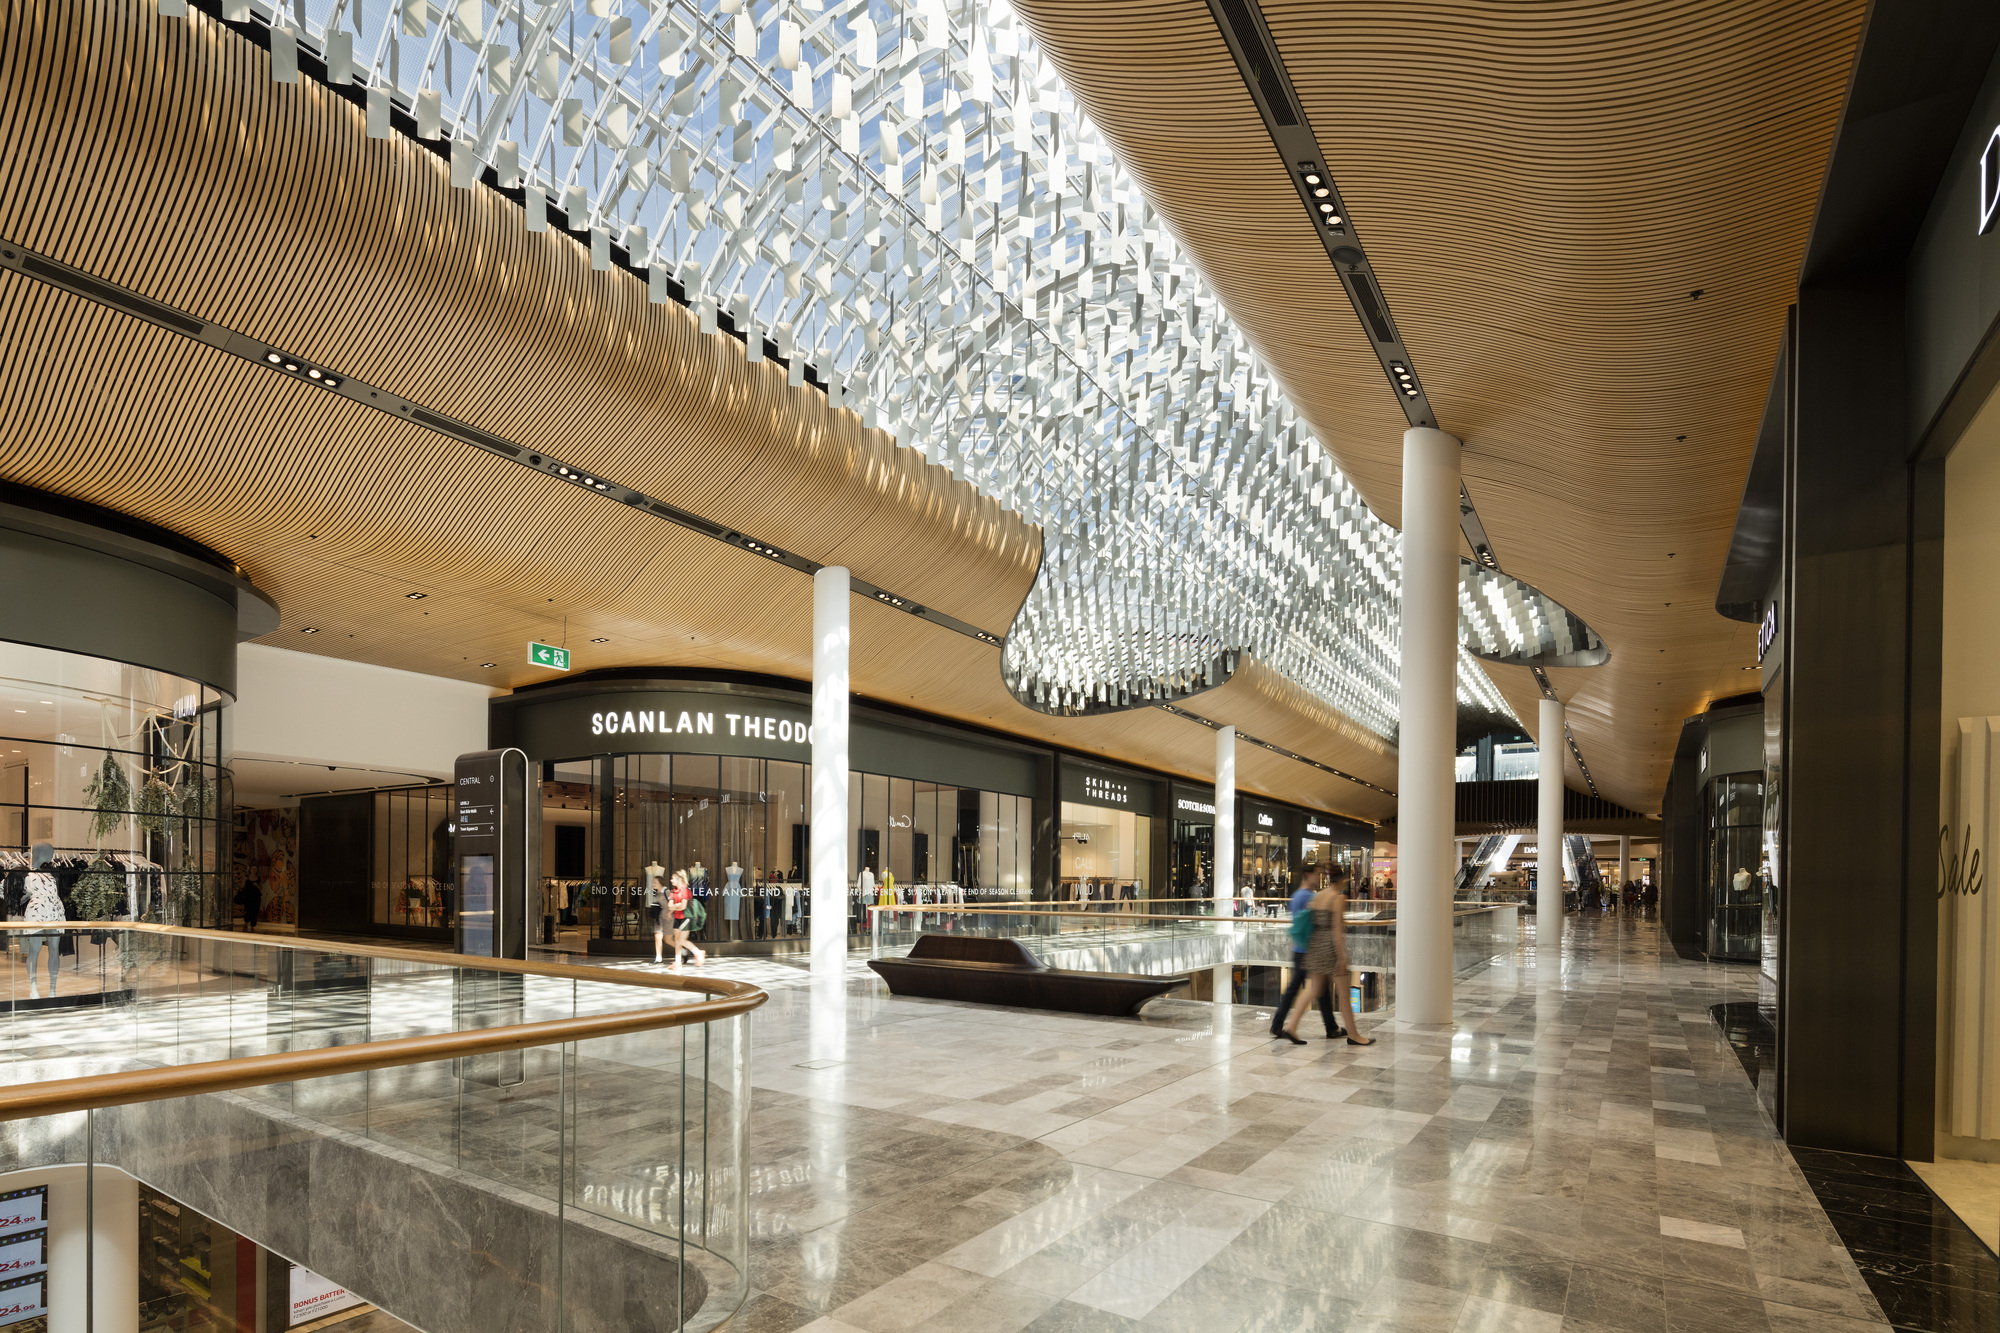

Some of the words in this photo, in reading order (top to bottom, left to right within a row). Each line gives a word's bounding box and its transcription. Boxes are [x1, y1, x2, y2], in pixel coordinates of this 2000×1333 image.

[592, 711, 714, 735] SCANLAN
[725, 713, 813, 744] THEOD
[460, 777, 480, 785] CENTRAL
[1086, 777, 1109, 790] SKIN
[1086, 788, 1127, 803] THREADS
[1524, 846, 1538, 854] DAV
[1075, 857, 1093, 869] CALL
[1938, 824, 1983, 899] Sale
[591, 886, 607, 895] END
[612, 886, 625, 896] OF
[760, 888, 780, 897] END
[785, 888, 797, 897] OF
[881, 888, 893, 896] END
[989, 888, 1009, 896] SEASON
[1076, 883, 1093, 895] WILD
[293, 1296, 319, 1309] BONUS
